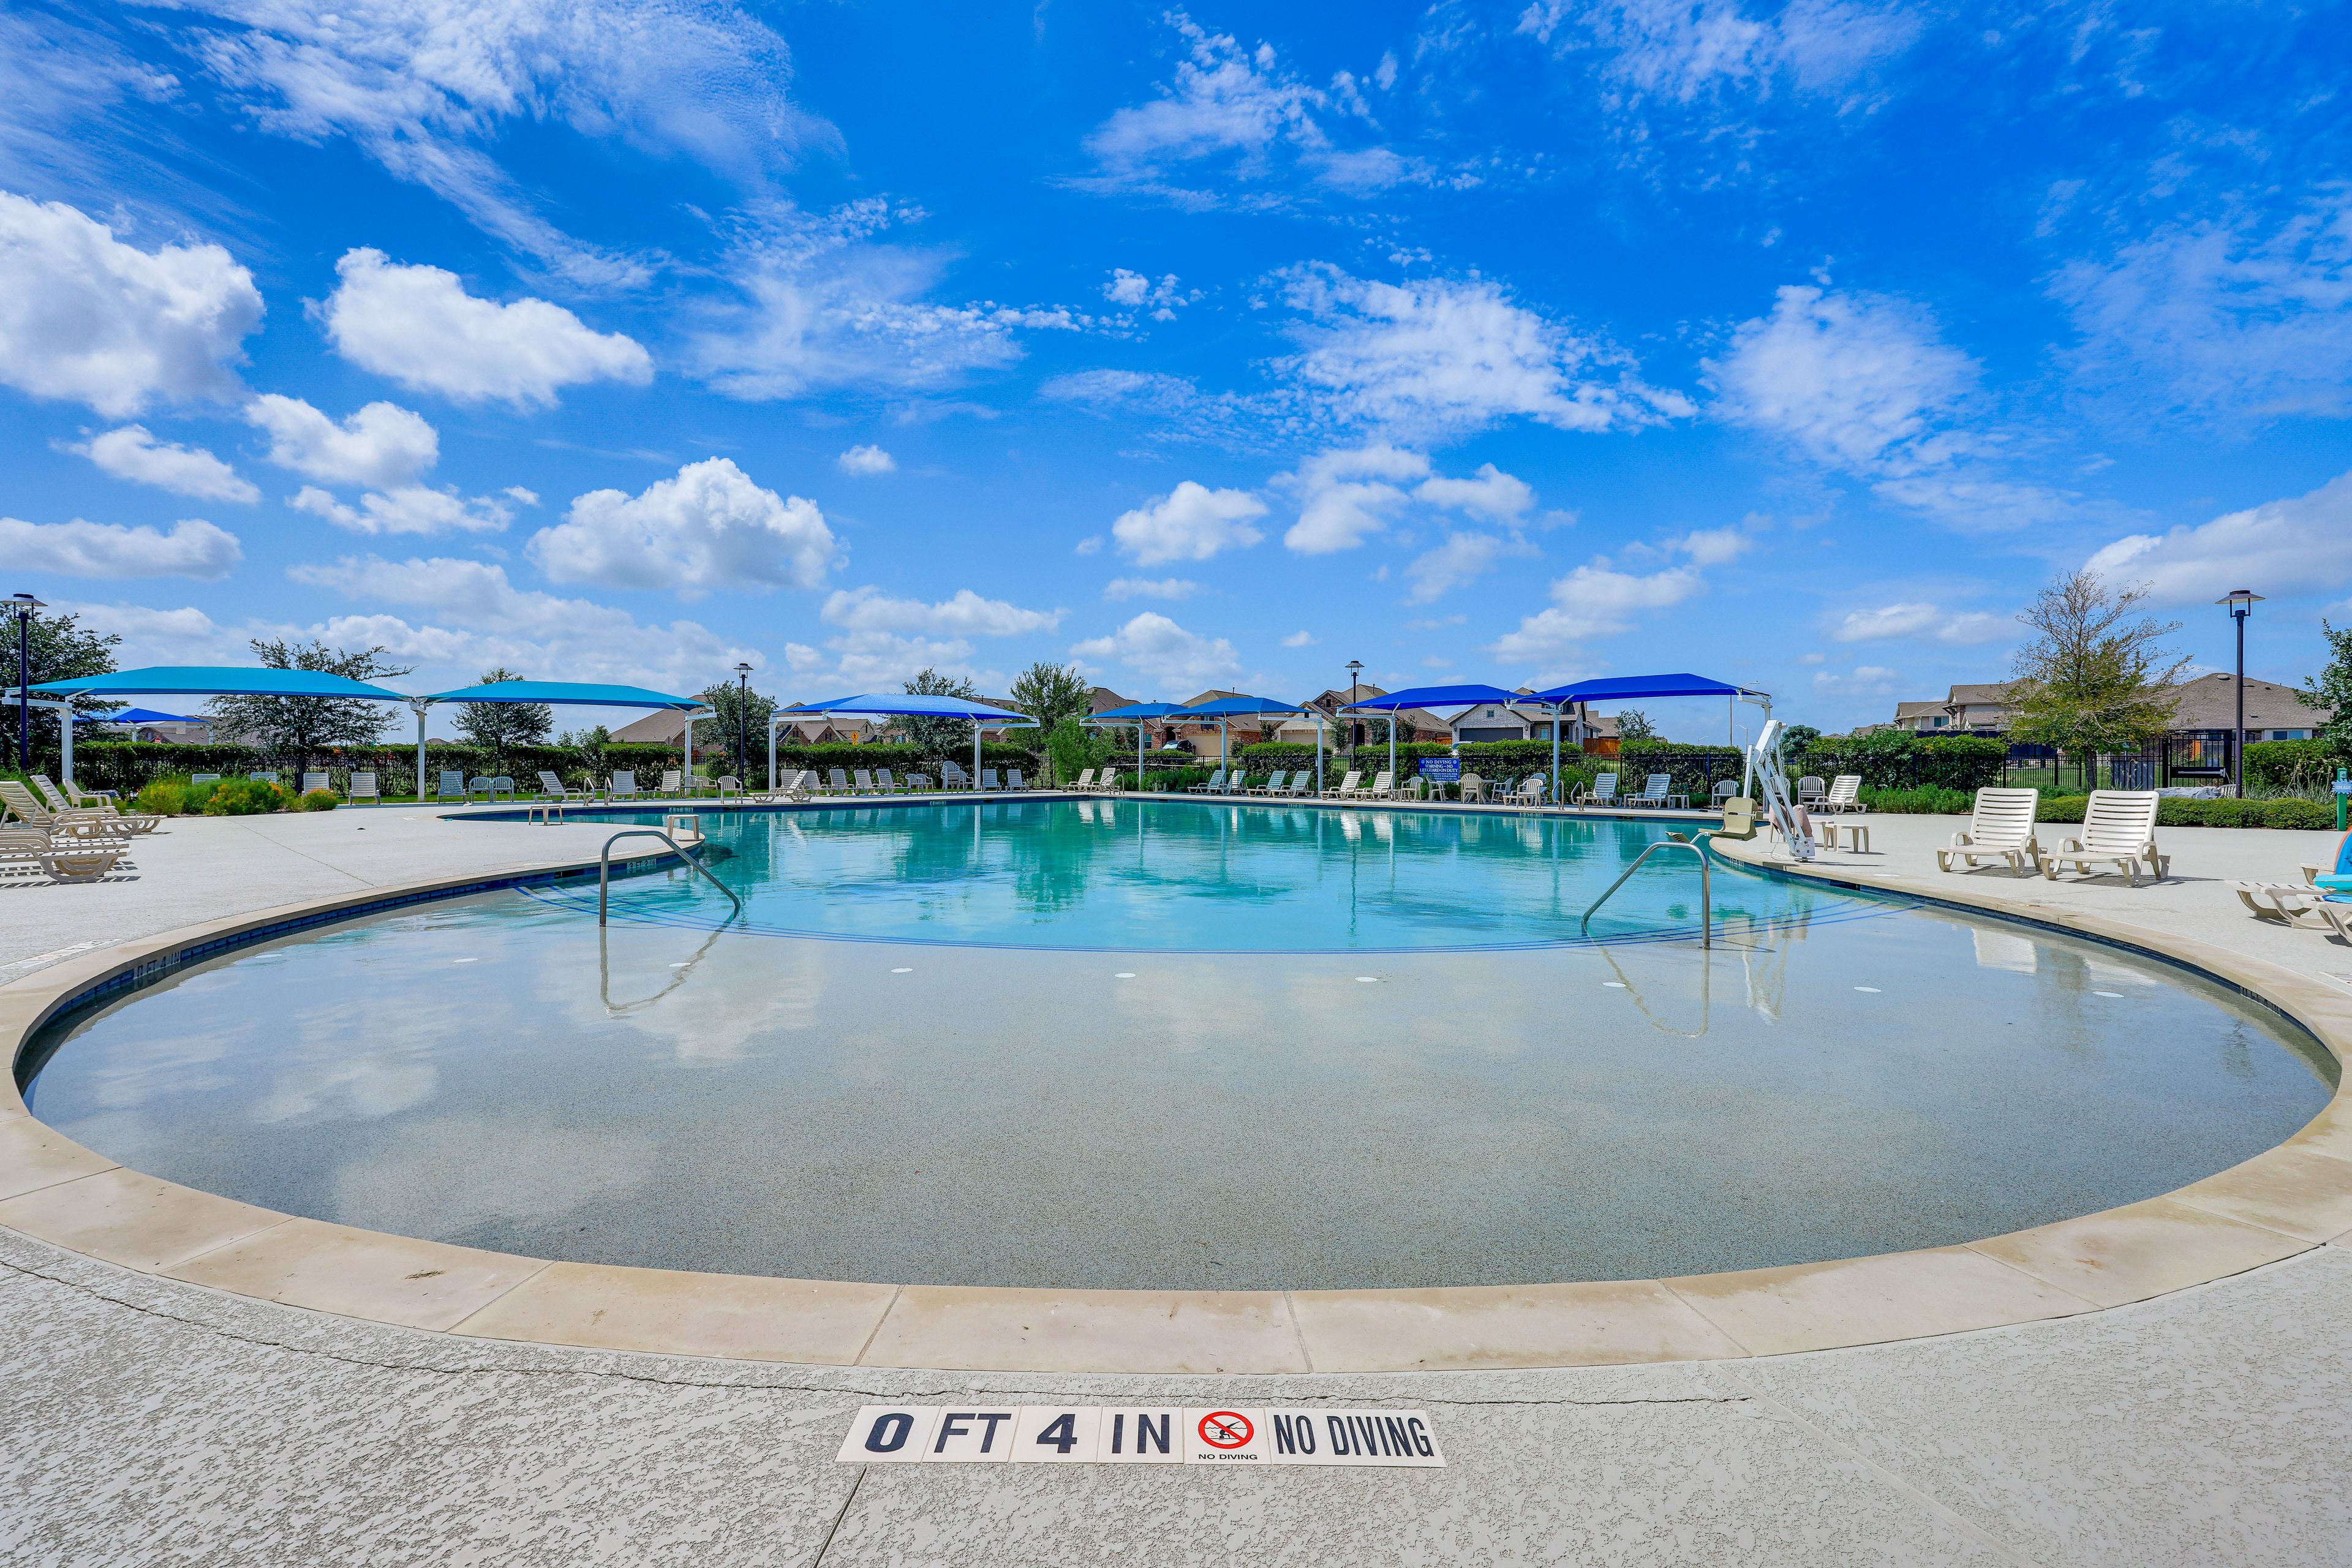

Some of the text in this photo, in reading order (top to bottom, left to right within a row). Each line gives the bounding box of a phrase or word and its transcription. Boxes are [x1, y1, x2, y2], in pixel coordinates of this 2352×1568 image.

[864, 1413, 1170, 1454] 0 FT 4 IN
[1274, 1414, 1434, 1457] NO DIVING
